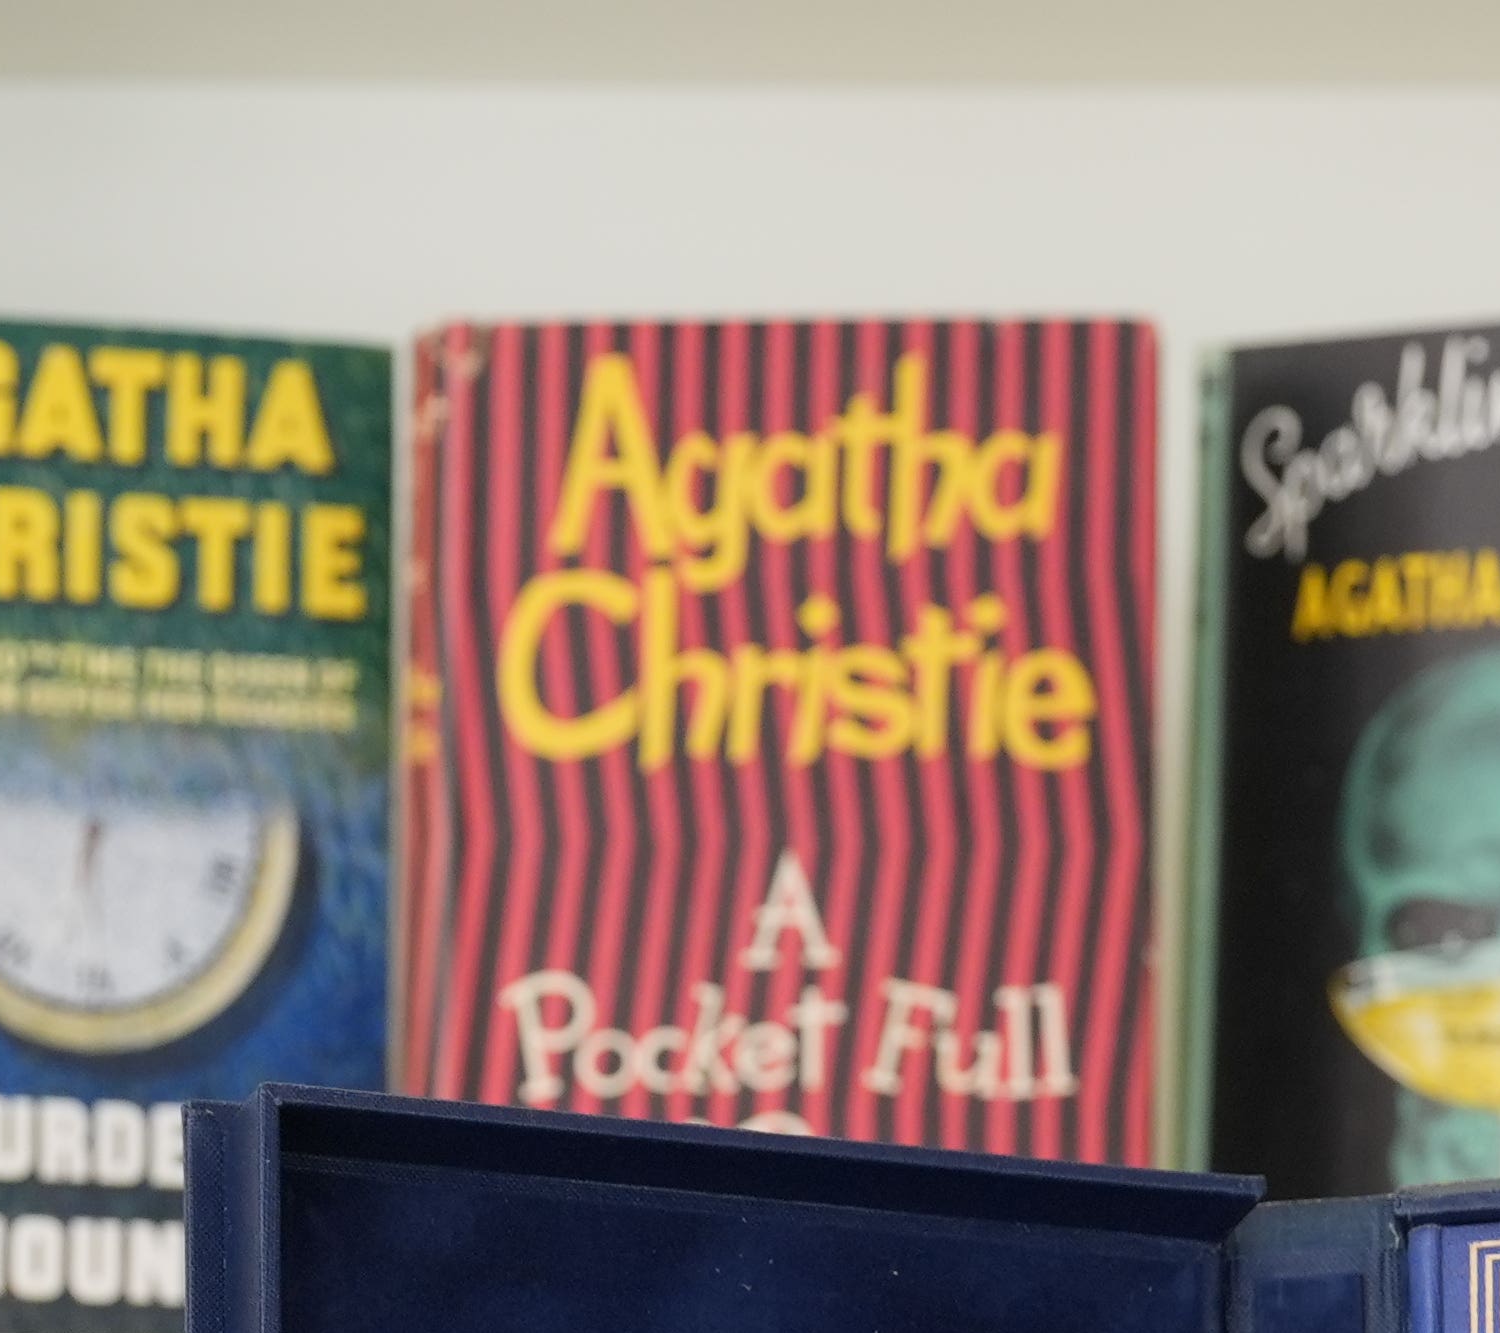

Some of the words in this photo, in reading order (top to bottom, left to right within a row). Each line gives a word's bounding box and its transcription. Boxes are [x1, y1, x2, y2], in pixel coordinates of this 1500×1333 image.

[550, 350, 1062, 593] Agatha
[499, 561, 1096, 773] Christie
[741, 847, 841, 972] A
[500, 968, 849, 1103] Pocket
[862, 976, 1078, 1101] Full
